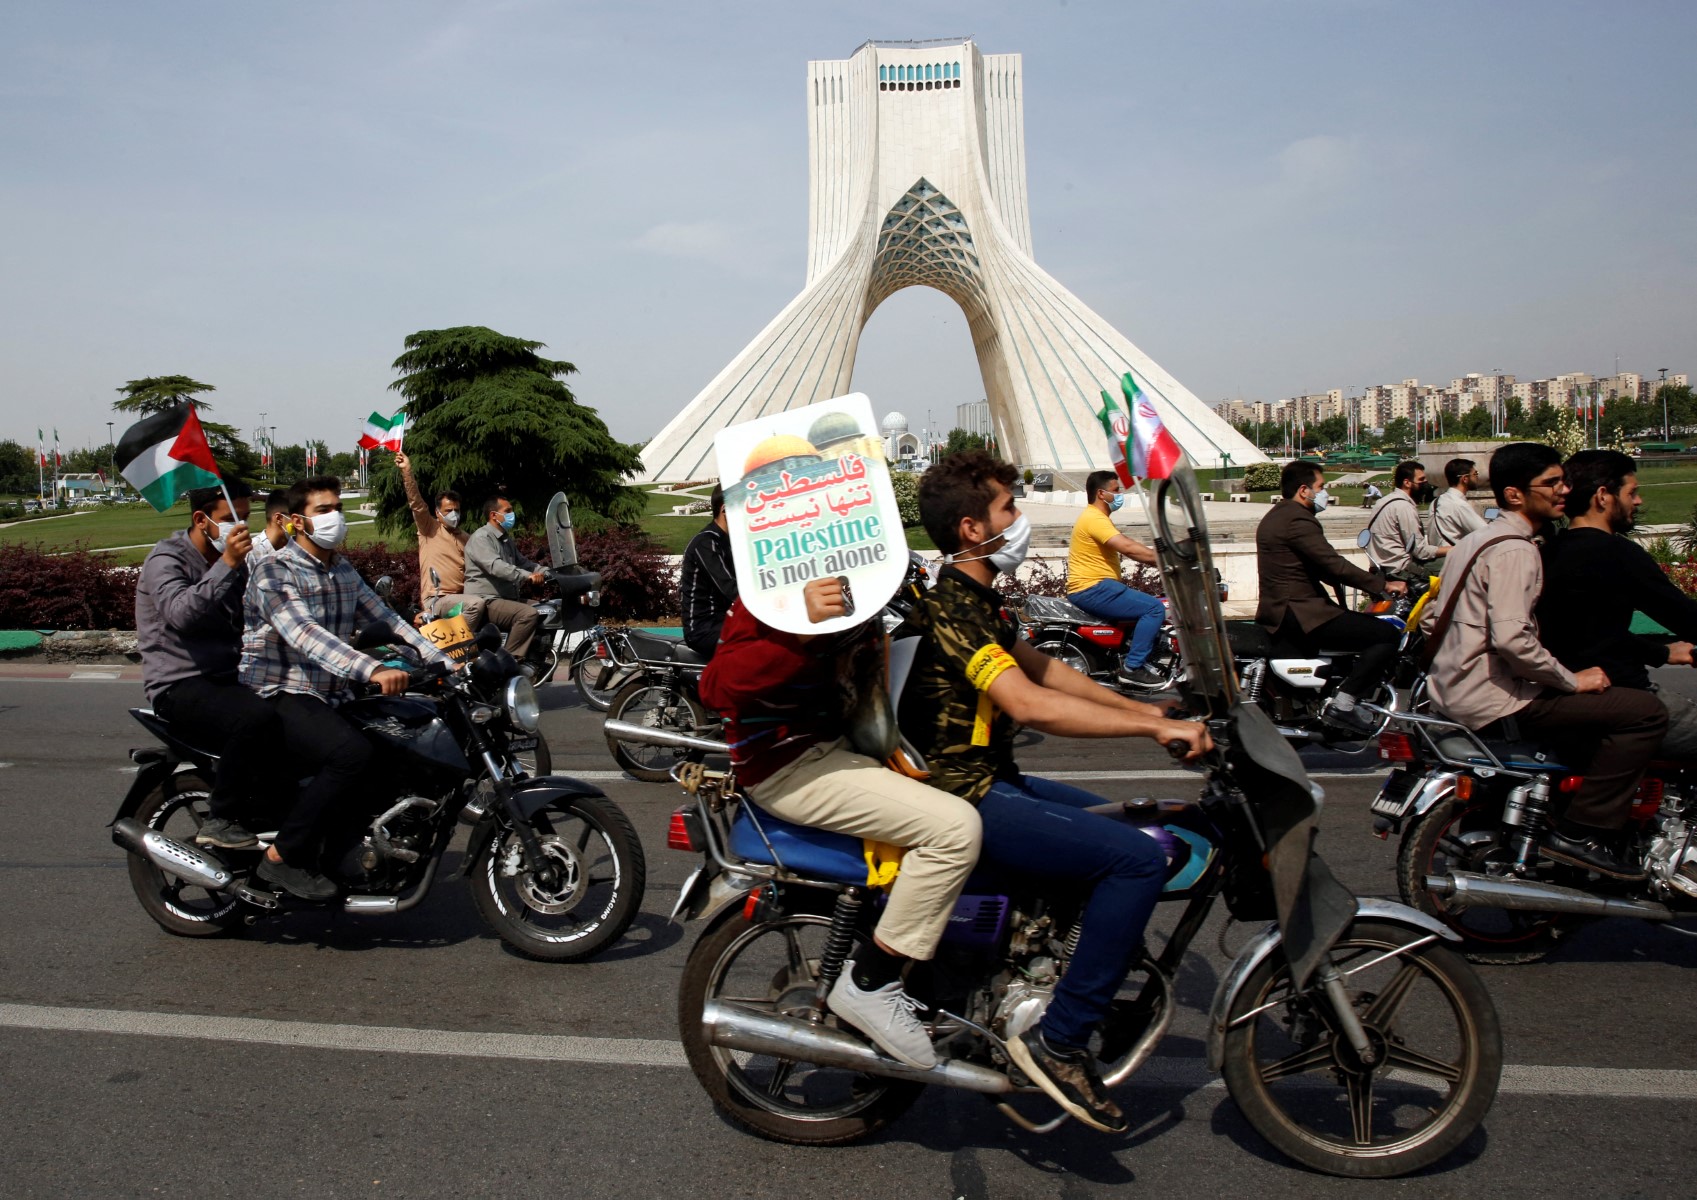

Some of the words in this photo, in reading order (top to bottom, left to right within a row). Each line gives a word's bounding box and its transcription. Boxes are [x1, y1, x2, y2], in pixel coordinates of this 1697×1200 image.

[746, 454, 866, 514] فلسطین
[825, 483, 873, 516] تنها
[748, 499, 820, 532] نیست
[753, 515, 881, 566] Palestine
[758, 568, 777, 590] is
[783, 555, 819, 584] not
[824, 543, 887, 574] alone
[214, 901, 237, 918] RACING
[601, 892, 617, 919] RACING
